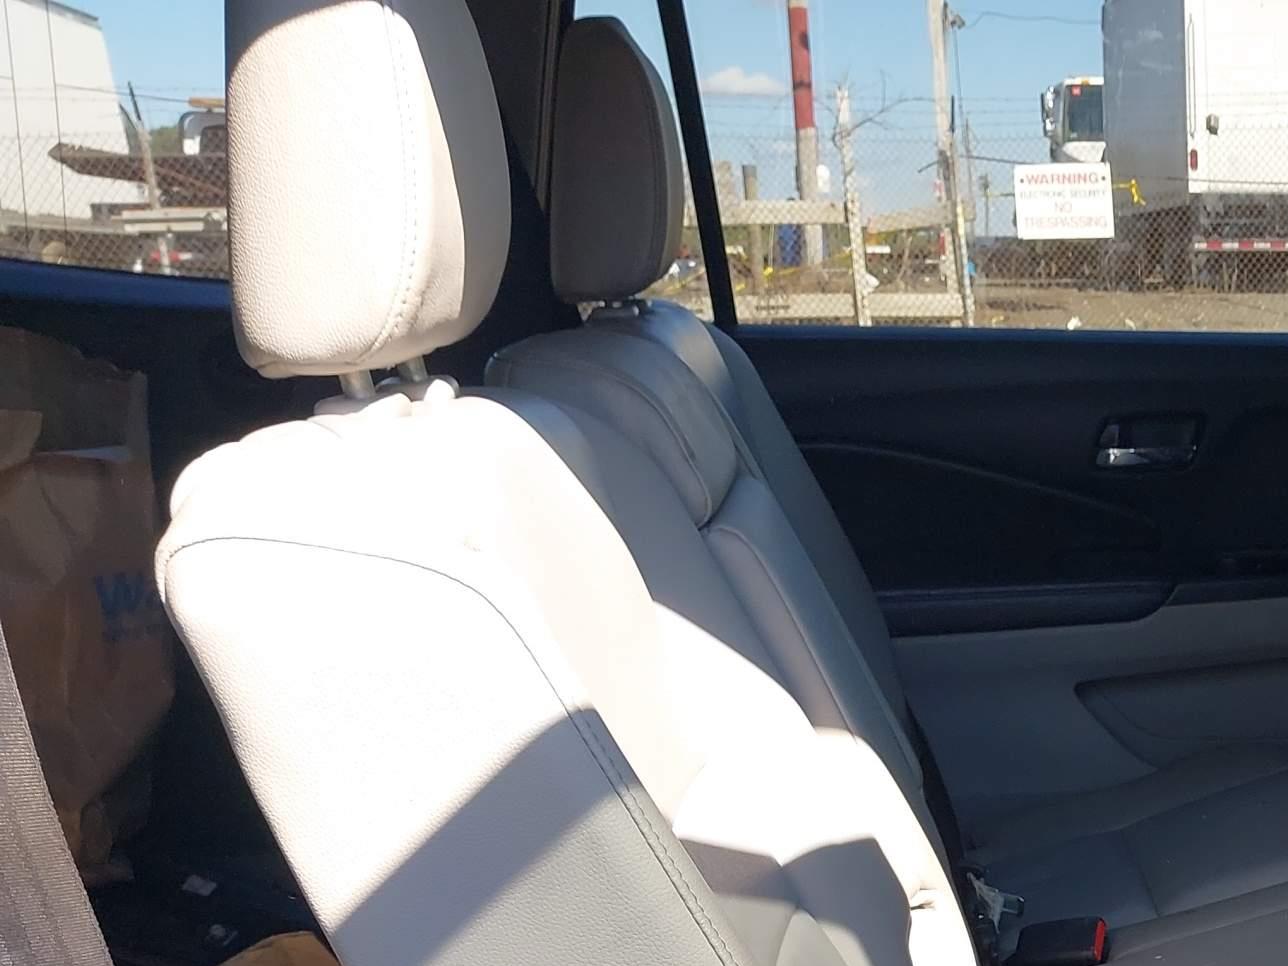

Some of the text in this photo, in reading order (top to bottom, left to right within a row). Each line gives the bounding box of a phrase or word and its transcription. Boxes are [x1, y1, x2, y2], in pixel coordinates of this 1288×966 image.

[1025, 172, 1099, 185] WARNING
[1054, 201, 1073, 213] NO
[1024, 216, 1108, 229] TRESPASSING
